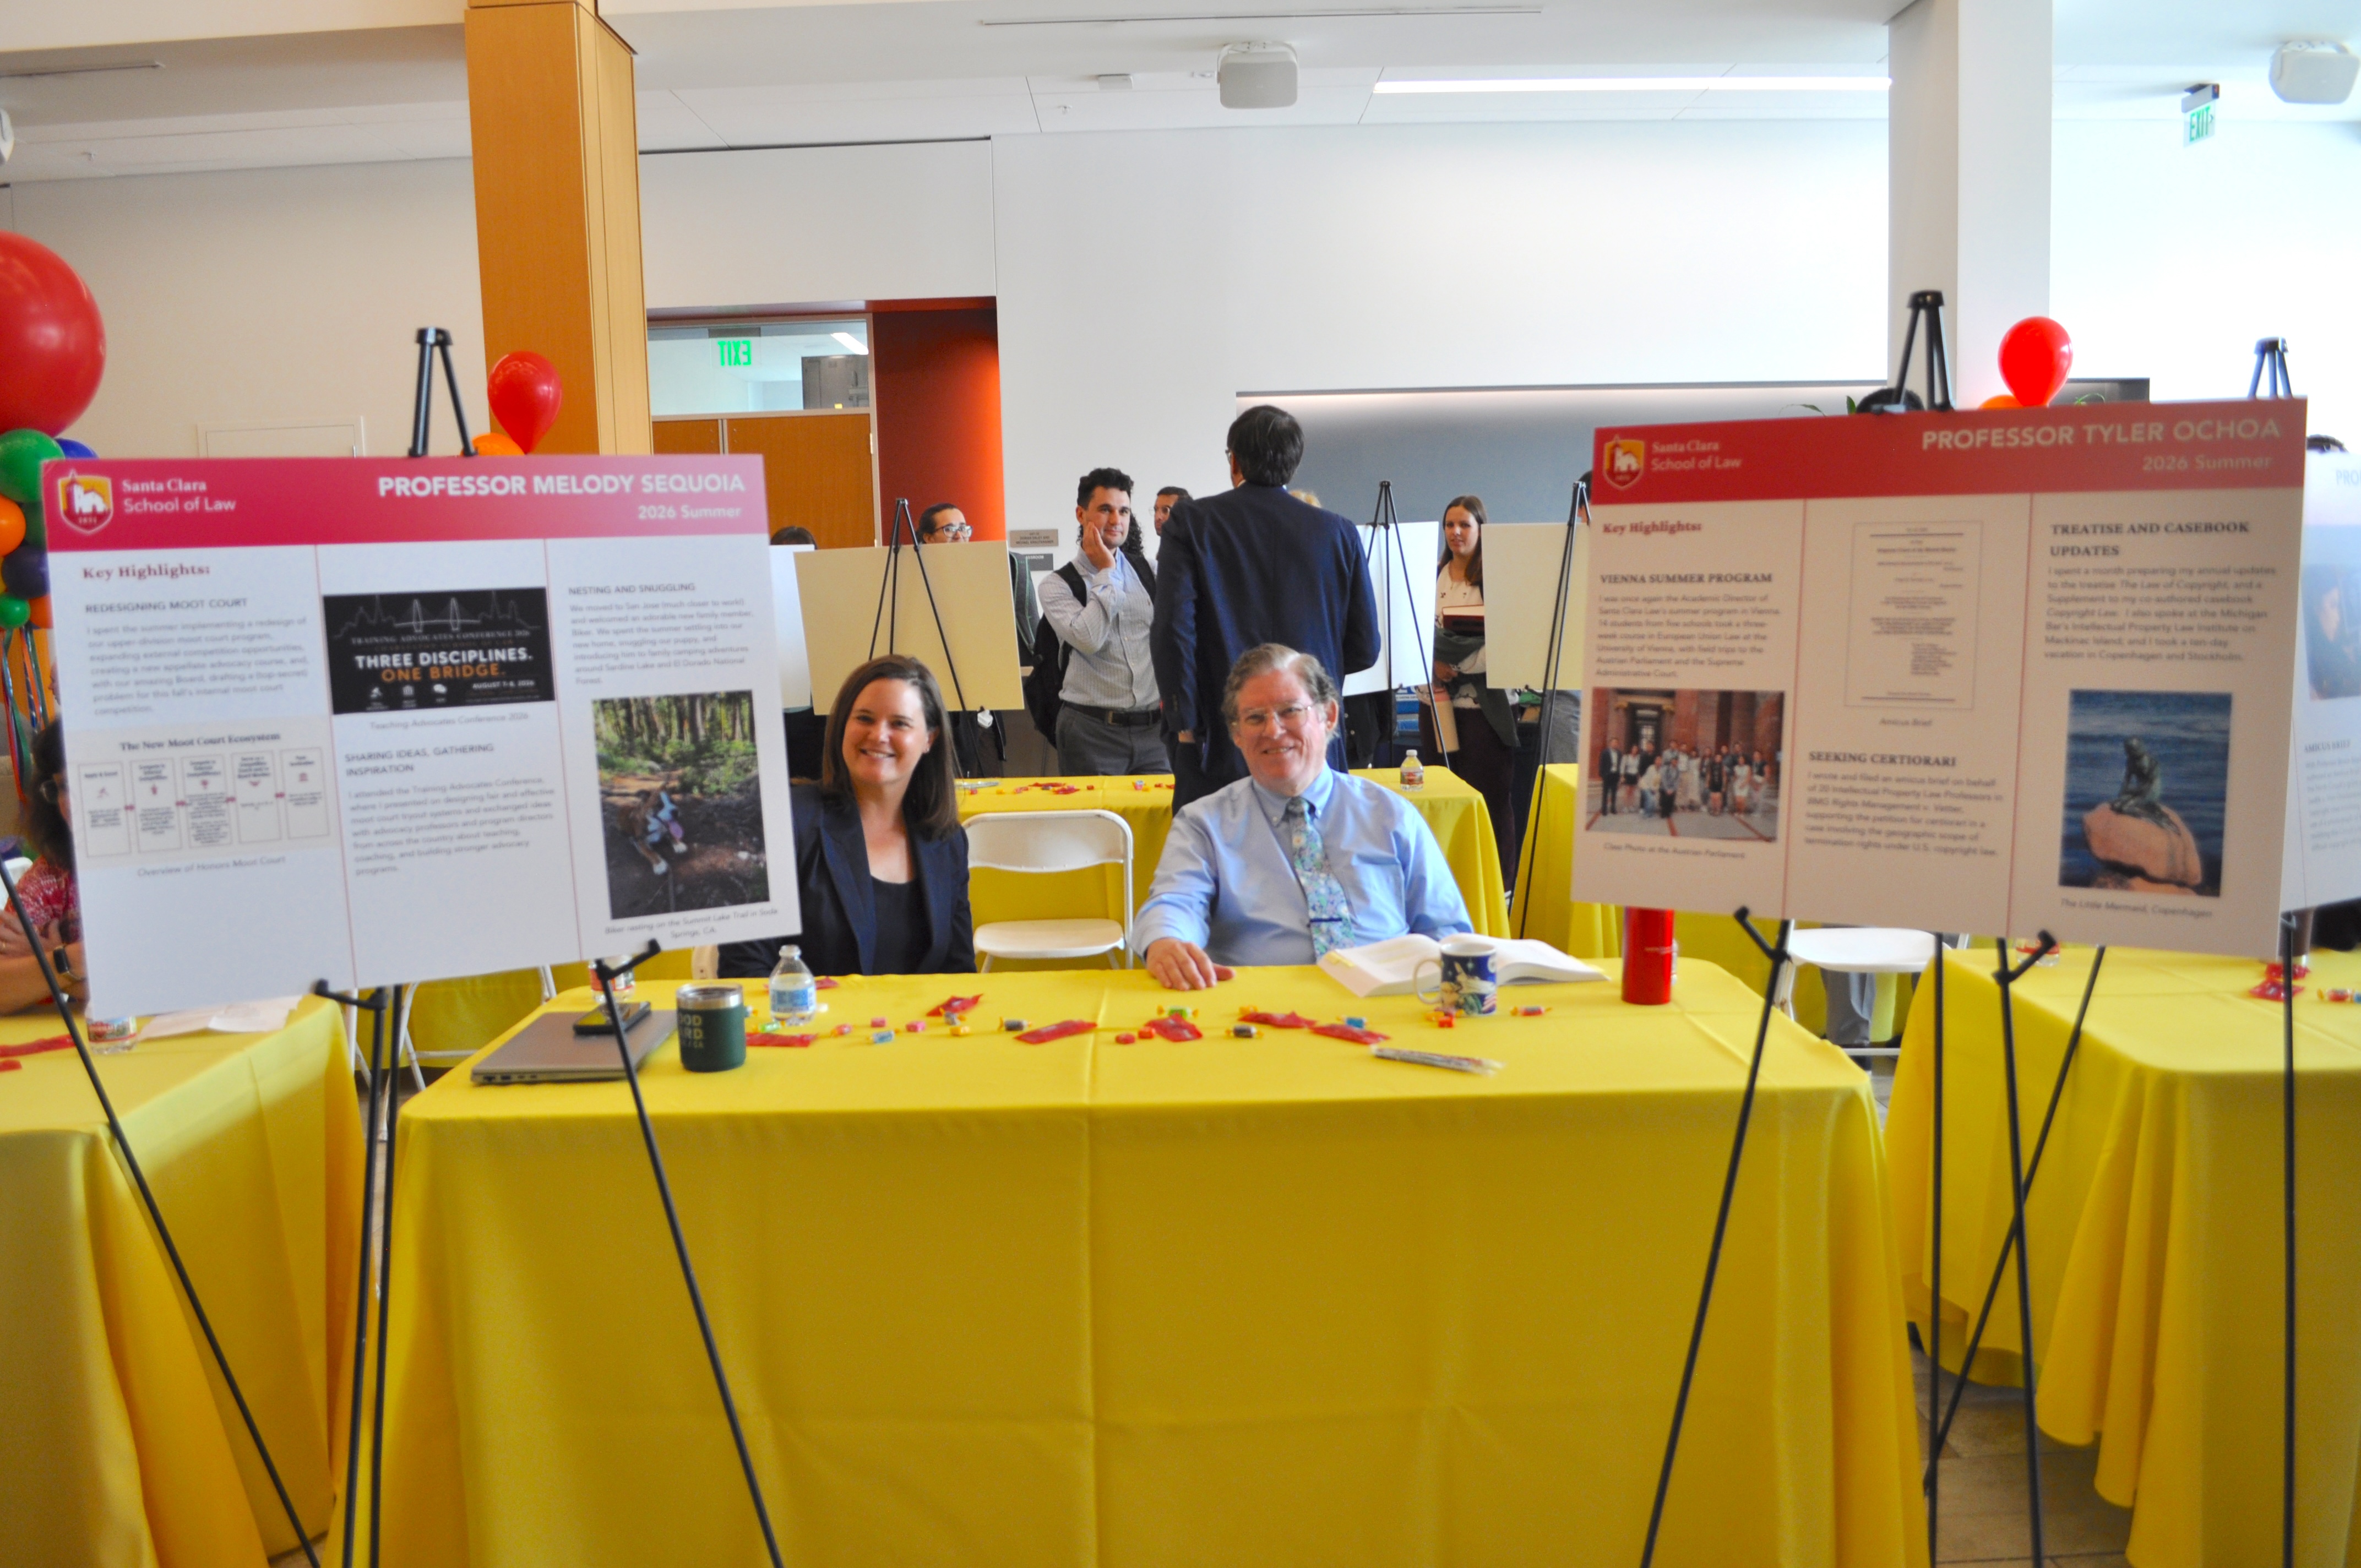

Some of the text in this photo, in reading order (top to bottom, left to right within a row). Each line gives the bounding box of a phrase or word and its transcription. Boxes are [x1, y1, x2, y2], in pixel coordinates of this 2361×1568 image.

[2190, 106, 2210, 142] EXIT
[1922, 419, 2281, 450] PROFESSOR TYLER OCHOA
[1652, 439, 1720, 453] Santa Clara
[1651, 457, 1742, 469] School of Law
[2143, 456, 2272, 471] 2026 Summer
[121, 478, 206, 492] Santa Clara
[379, 473, 745, 497] PROFESSOR MELODY SEQUOIA
[2336, 470, 2361, 486] PRO
[122, 498, 236, 512] School of Law
[639, 504, 744, 520] 2026 Summer
[1602, 524, 1626, 535] Key
[2053, 523, 2250, 535] TREATISE AND CASEBOOK
[2050, 545, 2120, 557] UPDATES
[83, 567, 112, 581] Key
[1601, 574, 1772, 584] VIENNA SUMMER PROGRAM
[568, 582, 695, 595] NESTING AND SNUGGLING
[85, 599, 246, 613] REDESIGNING MOOT COURT
[356, 647, 534, 669] THREE DISCIPLINES.
[381, 668, 421, 683] ONE
[369, 711, 529, 732] Teaching Advocates Conference 2026
[120, 731, 280, 751] The New Moot Court Ecosystem
[345, 750, 393, 763] SHARING
[433, 743, 494, 756] GATHERING
[1809, 752, 1956, 766] SEEKING CERTIORARI
[346, 764, 414, 777] INSPIRATION
[137, 853, 286, 877] Overview of Honors Moot Court
